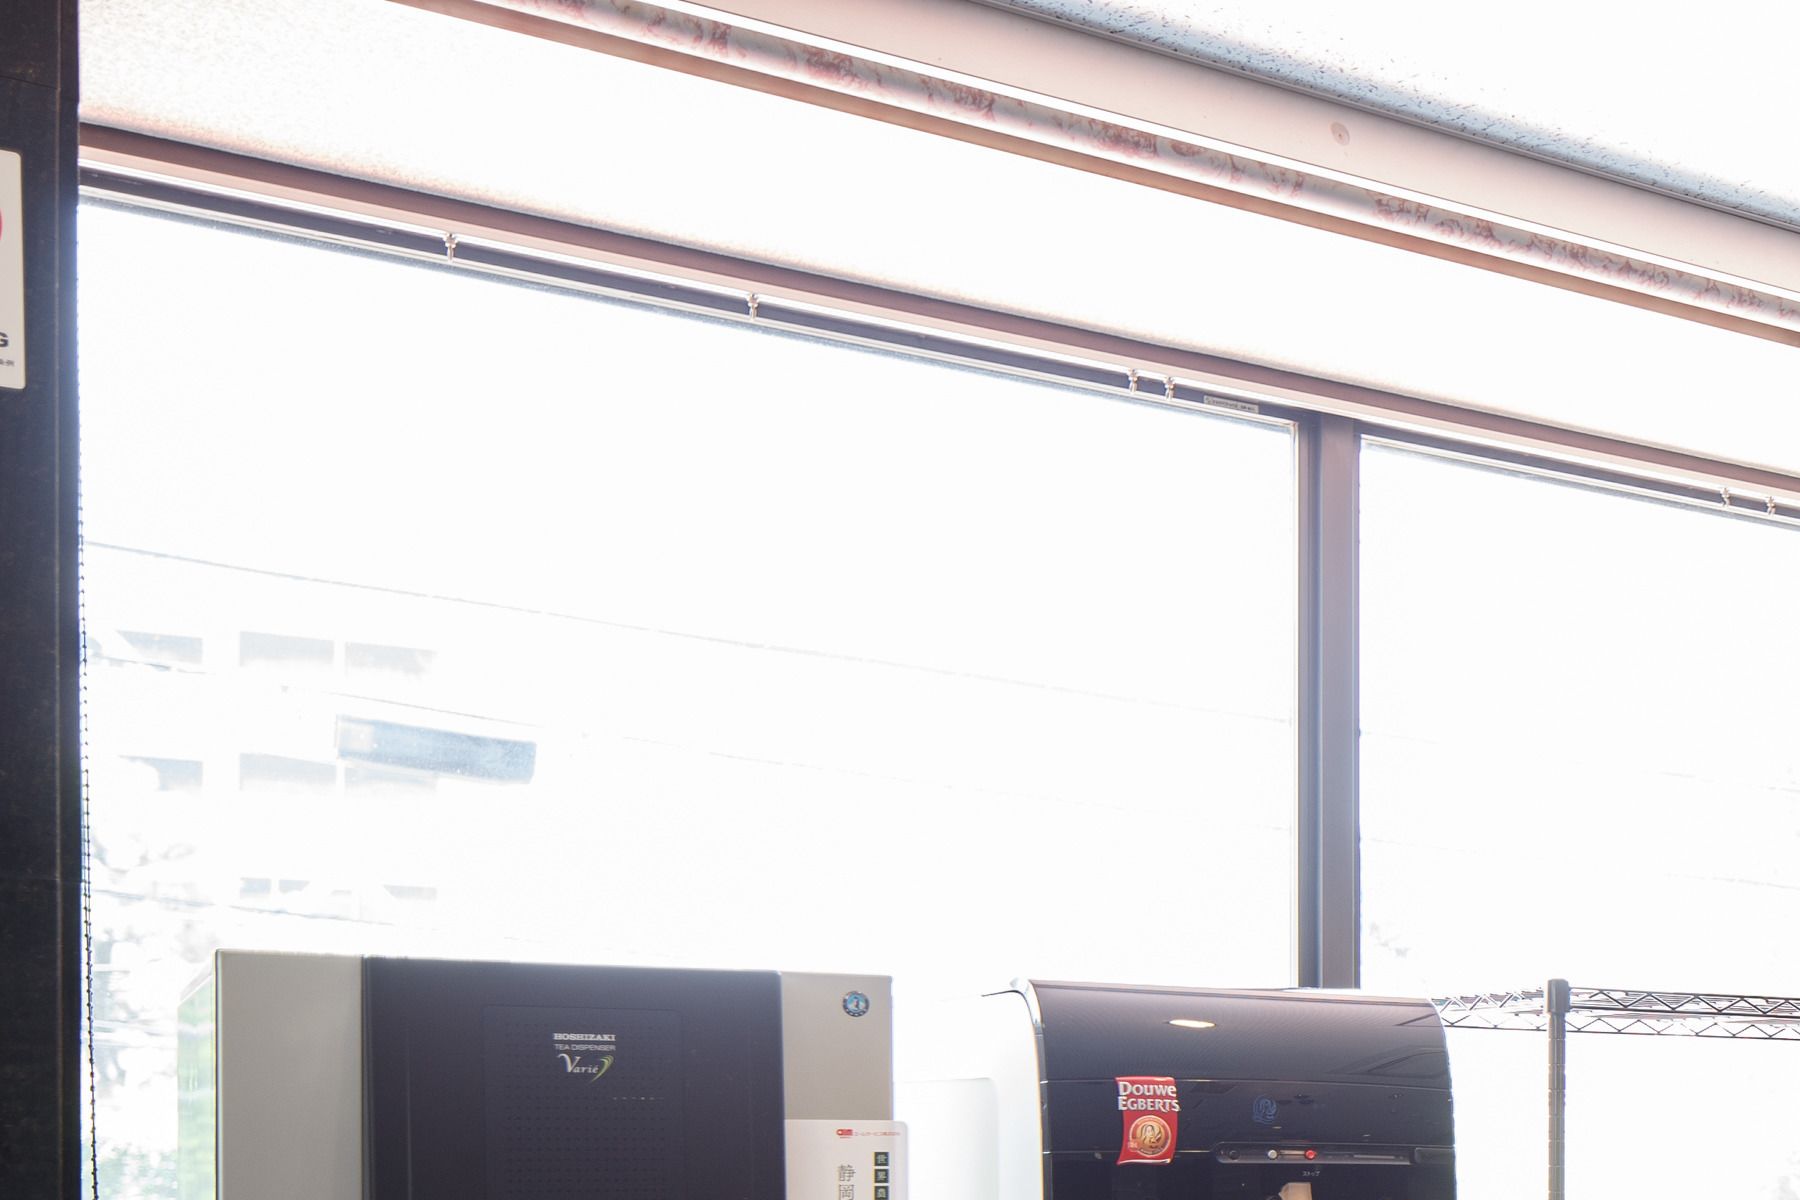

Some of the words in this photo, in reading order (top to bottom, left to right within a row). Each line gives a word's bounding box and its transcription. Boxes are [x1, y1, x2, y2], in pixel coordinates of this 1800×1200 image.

[553, 1033, 616, 1041] HOSHIZAKI
[554, 1043, 570, 1051] TEA
[1119, 1082, 1177, 1097] Douwe
[1118, 1096, 1181, 1112] EGBERTS
